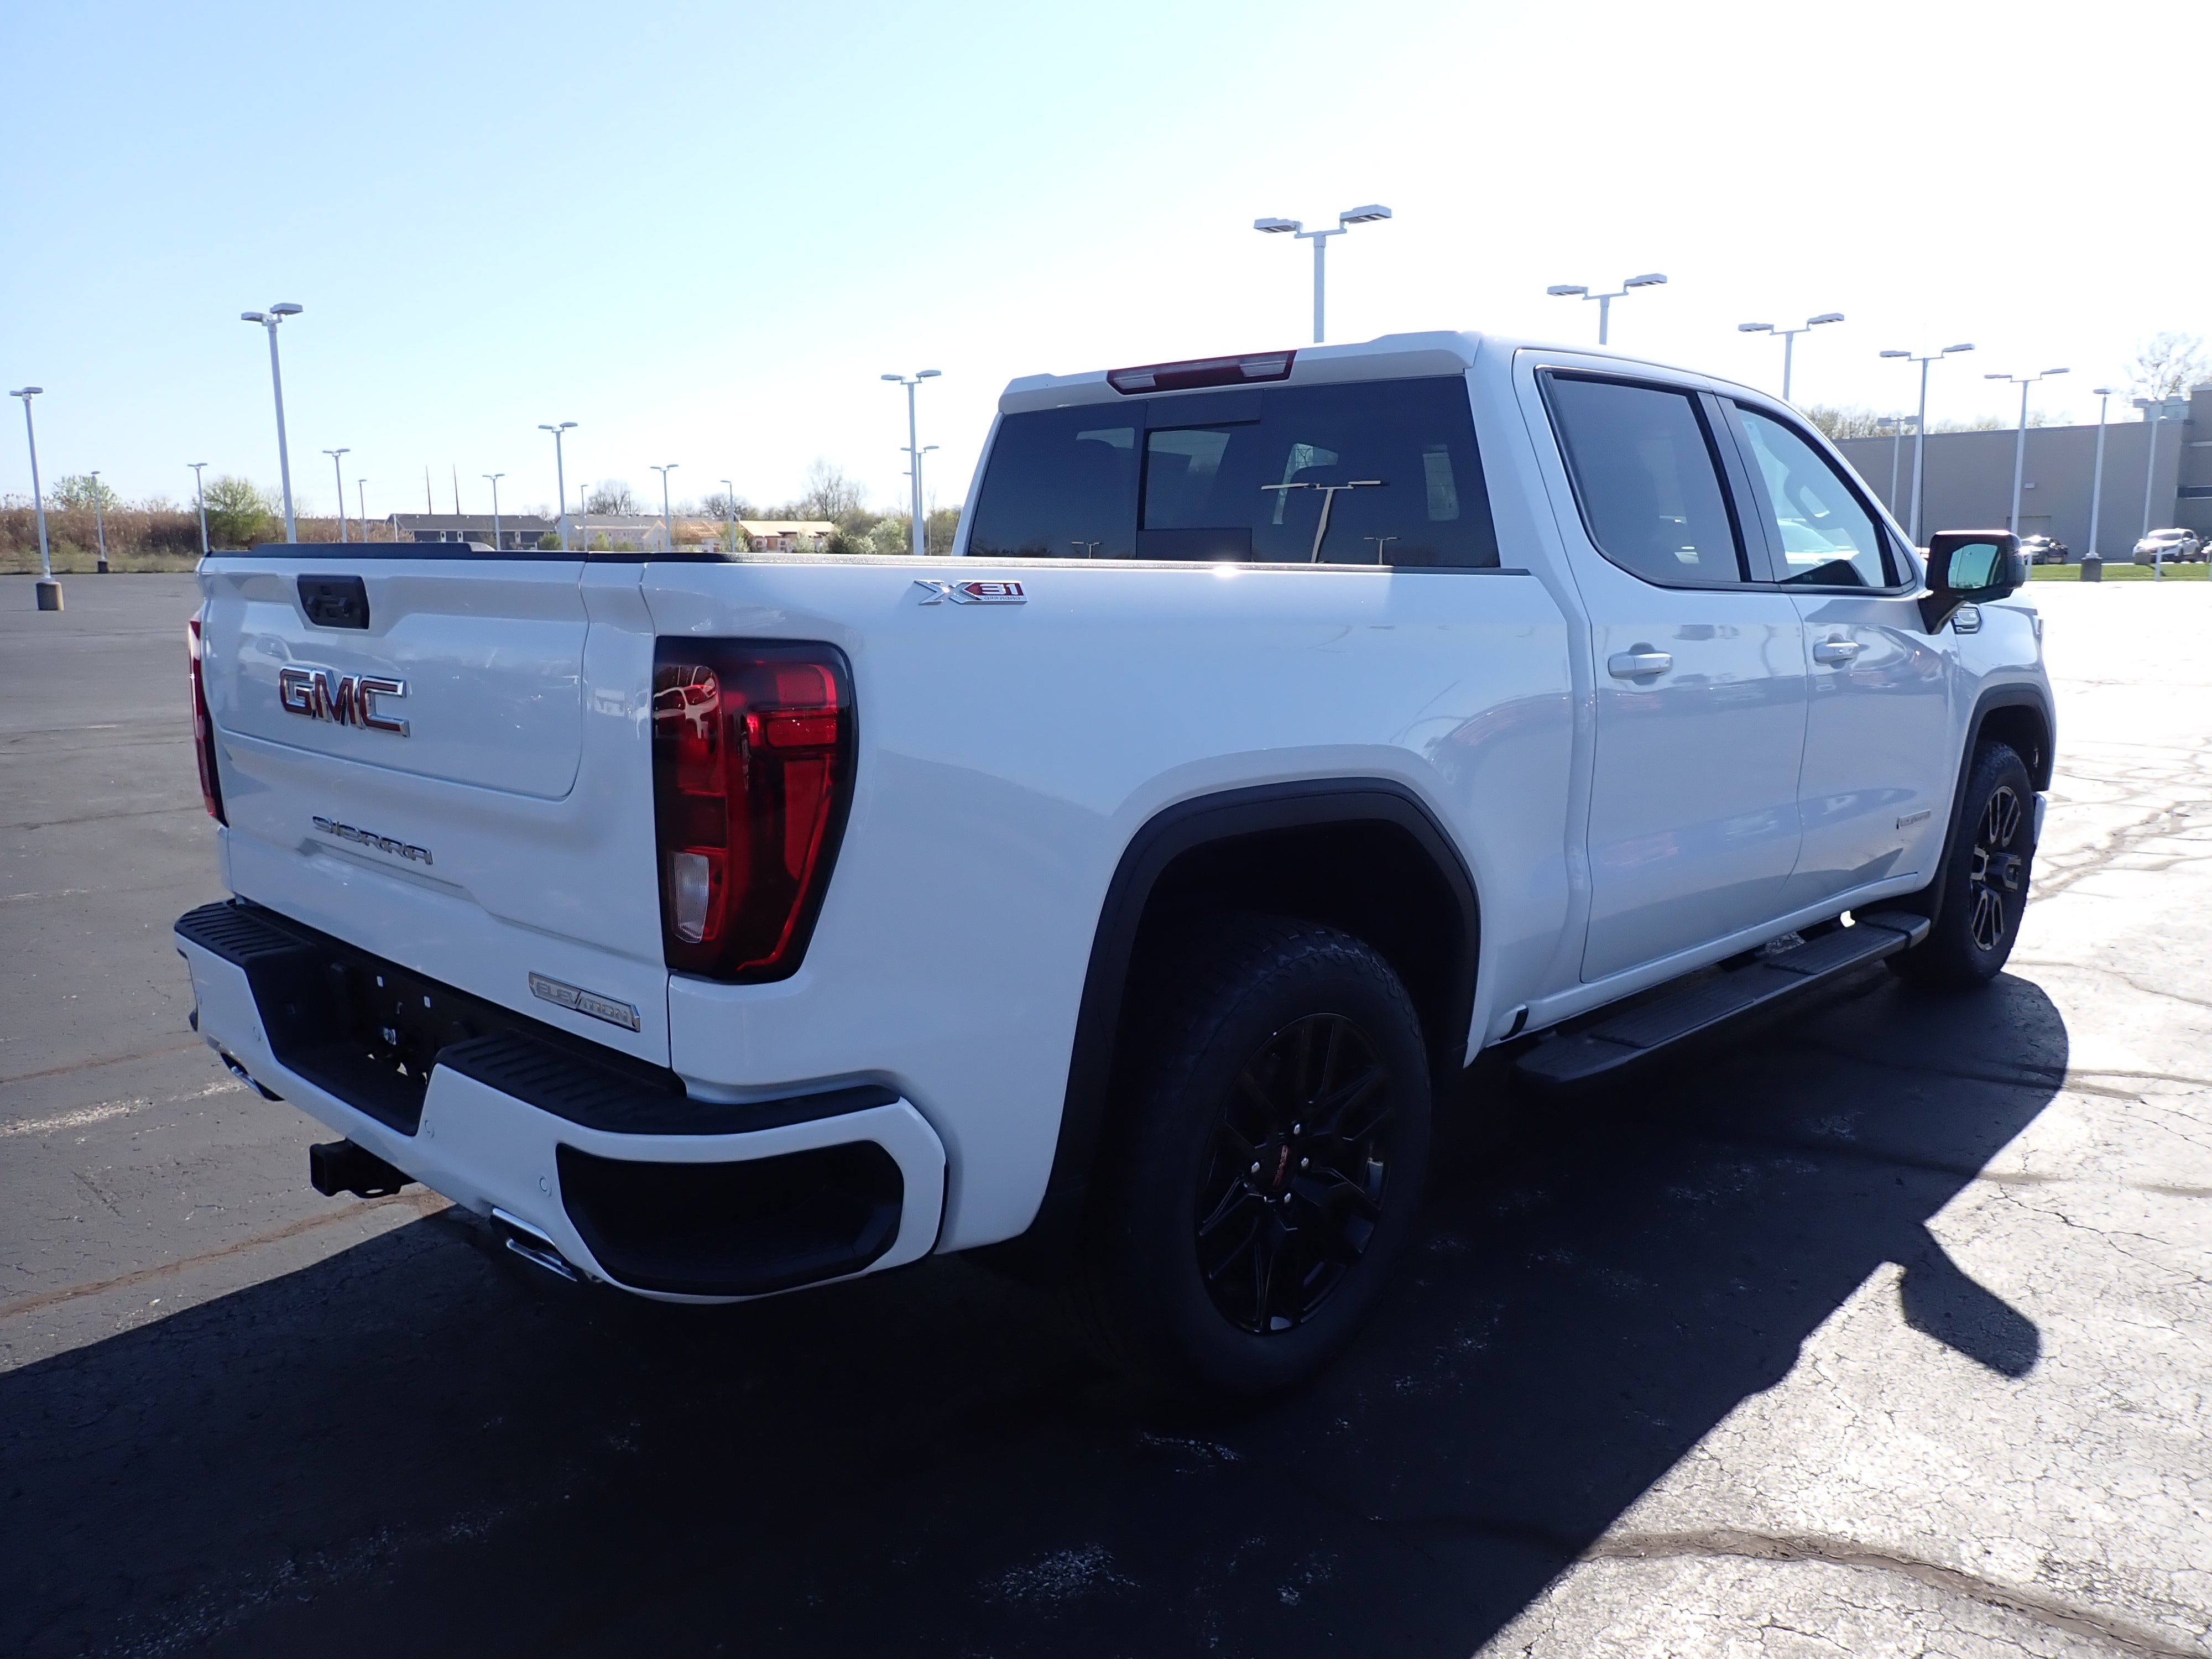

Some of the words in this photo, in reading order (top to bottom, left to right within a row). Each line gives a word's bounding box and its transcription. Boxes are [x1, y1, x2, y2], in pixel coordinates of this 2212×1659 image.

[914, 580, 1025, 605] X31
[279, 664, 410, 738] GMC
[312, 815, 434, 865] SIERRA
[535, 980, 629, 1023] ELEVATION
[1272, 1145, 1288, 1186] GMC
